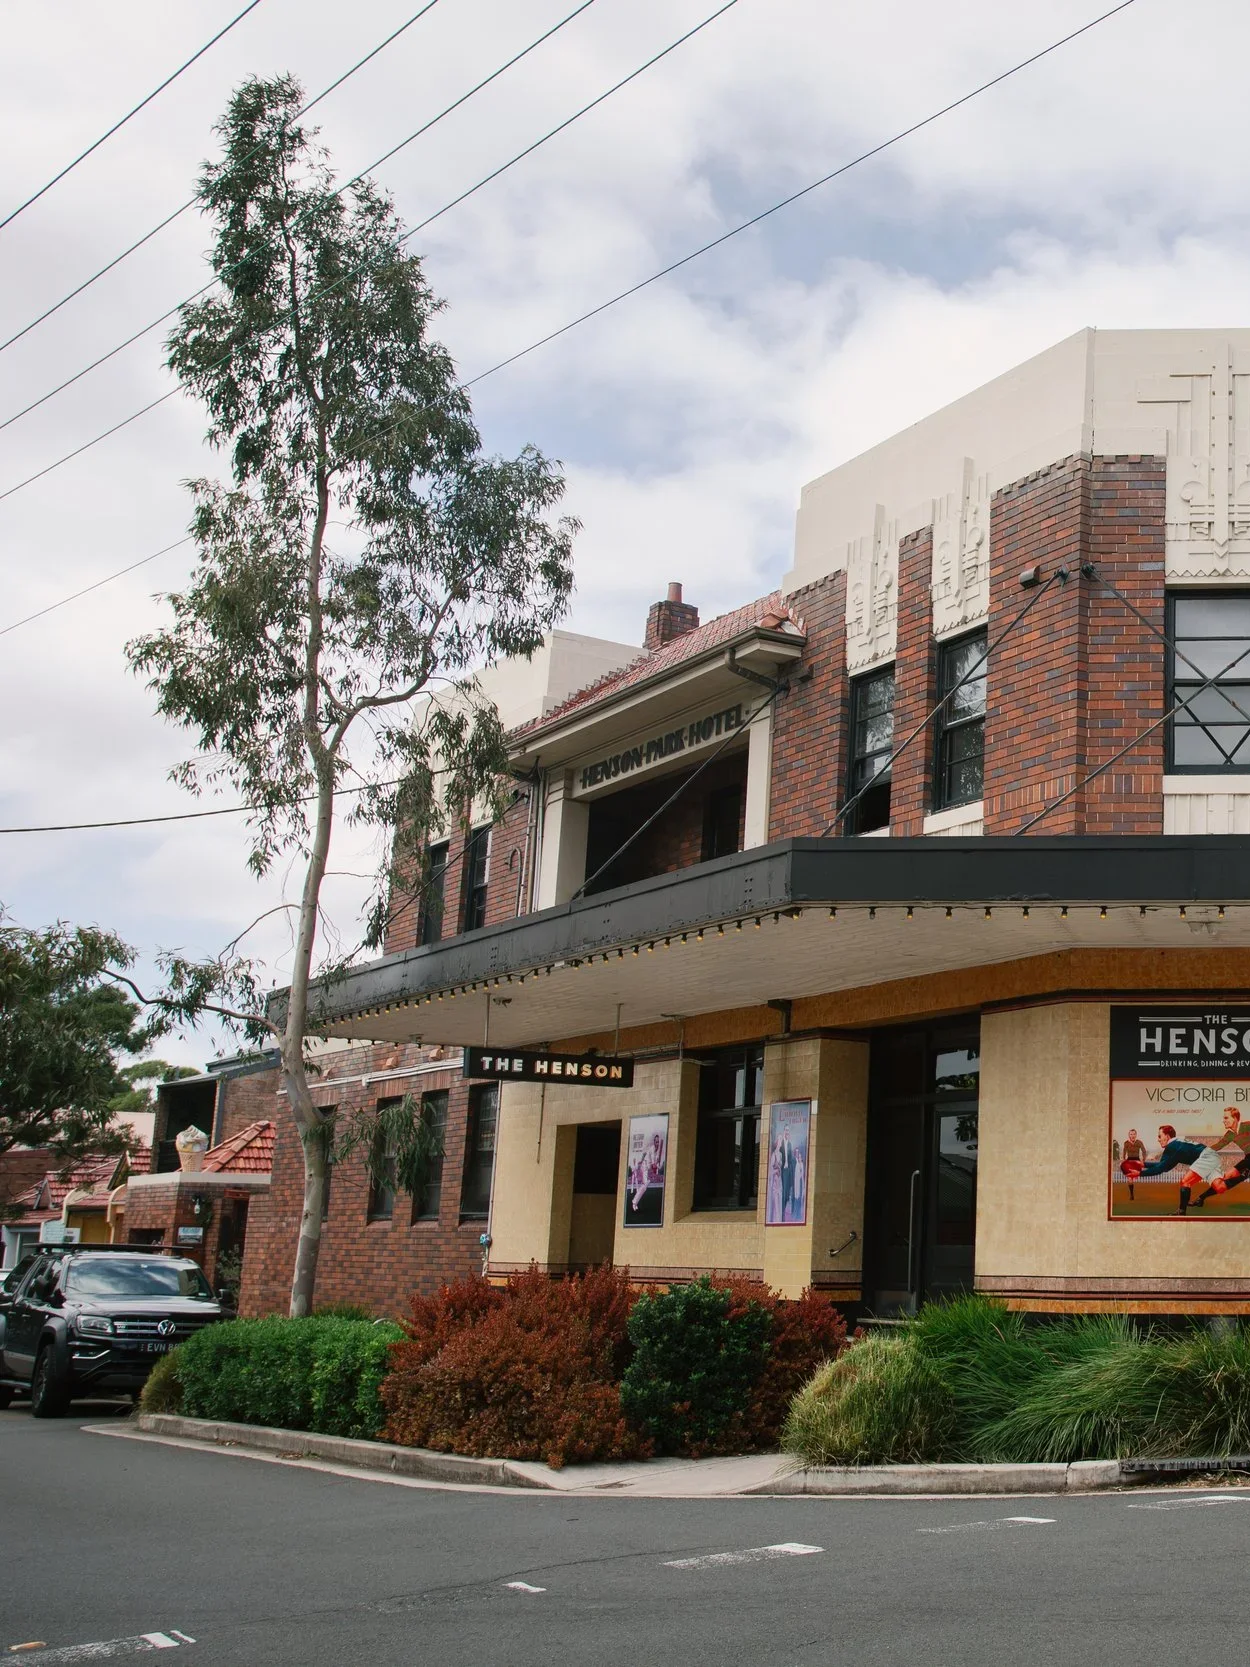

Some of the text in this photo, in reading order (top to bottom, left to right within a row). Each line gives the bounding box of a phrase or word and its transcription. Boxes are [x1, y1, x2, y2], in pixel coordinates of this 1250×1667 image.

[581, 703, 745, 789] HENSON PARK HOTEL
[1204, 1014, 1228, 1025] THE
[481, 1056, 623, 1079] THE HENSON
[1145, 1087, 1225, 1102] VICTORIA
[147, 1342, 166, 1352] EVN
